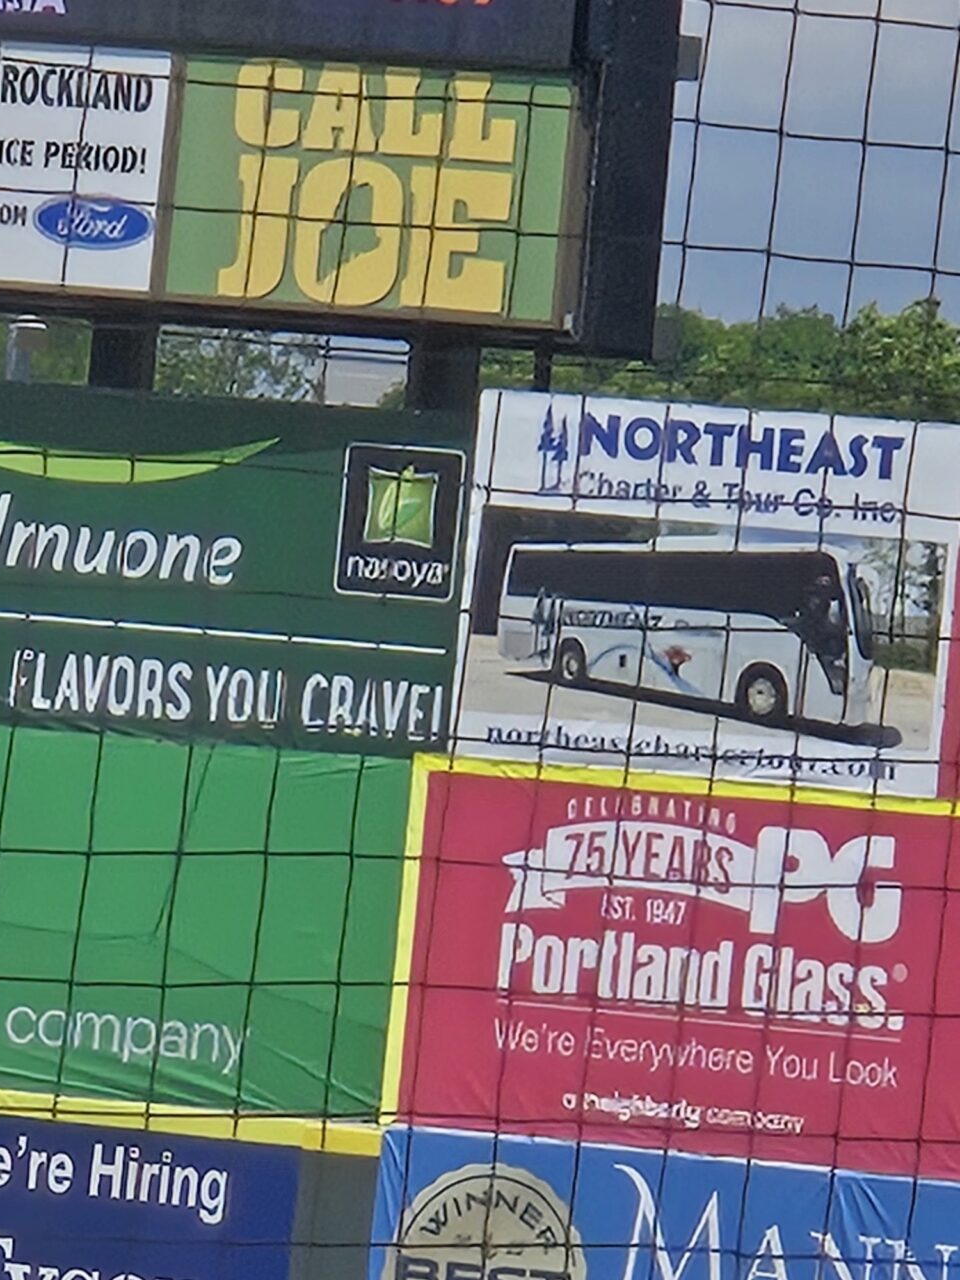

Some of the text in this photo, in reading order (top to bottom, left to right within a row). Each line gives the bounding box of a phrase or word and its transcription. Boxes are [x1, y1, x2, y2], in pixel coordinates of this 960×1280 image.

[0, 63, 154, 113] ROCKLAND
[234, 57, 517, 164] CALL
[44, 138, 148, 175] PERIOD!
[55, 200, 127, 240] Ford
[216, 153, 513, 315] JOE
[580, 412, 905, 481] NORTHEAST
[577, 470, 682, 503] Charter
[692, 483, 711, 509] &
[10, 645, 192, 722] FLAVORS
[206, 663, 285, 729] YOU
[301, 673, 445, 741] CRAVE!
[565, 829, 735, 895] 75 YEARS
[749, 826, 903, 944] PG
[497, 922, 734, 1008] Portland
[5, 1004, 249, 1075] company
[493, 1017, 898, 1088] We're Everywhere You Look
[89, 1143, 231, 1225] Hiring
[420, 1189, 559, 1256] WINNER
